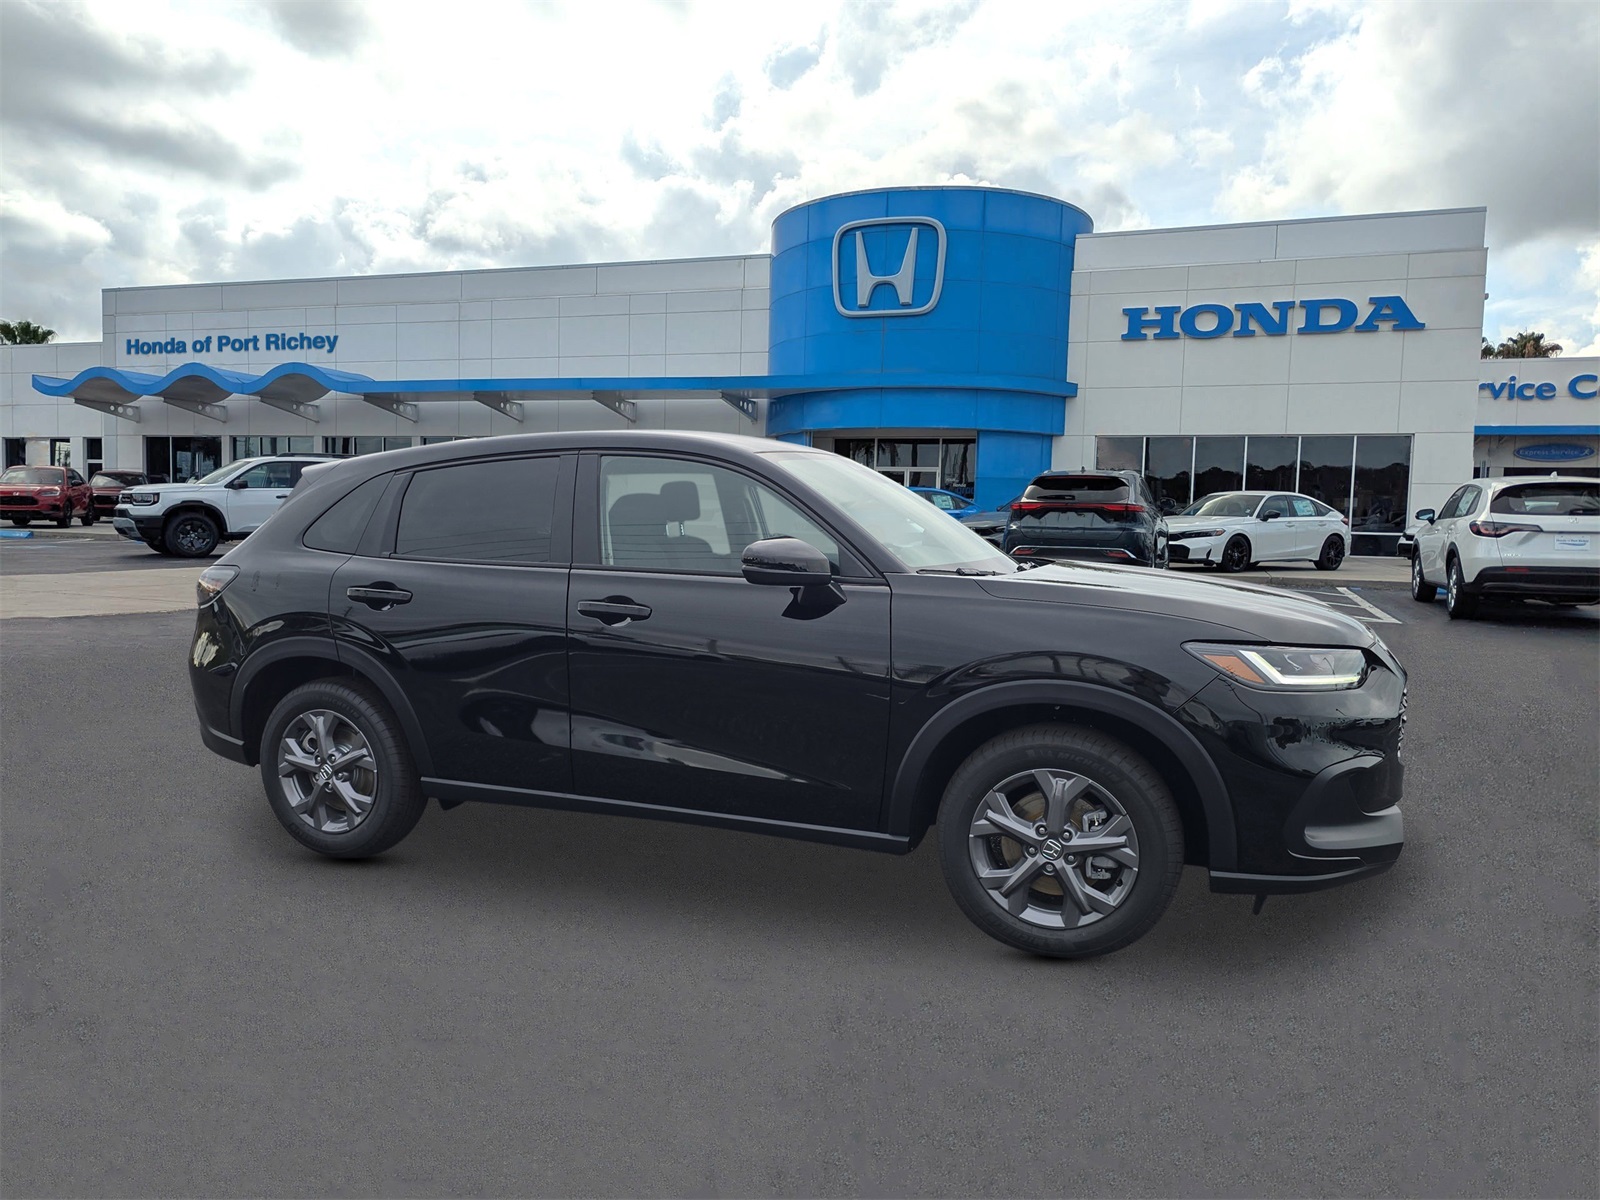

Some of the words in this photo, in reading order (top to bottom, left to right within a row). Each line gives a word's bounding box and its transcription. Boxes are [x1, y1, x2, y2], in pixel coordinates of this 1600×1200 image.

[1120, 294, 1426, 341] HONDA
[125, 336, 188, 355] Honda
[191, 336, 213, 354] of
[217, 335, 260, 353] Port
[264, 332, 340, 355] Richey
[1567, 374, 1600, 400] C
[1519, 448, 1549, 456] Express
[1551, 448, 1579, 456] Service
